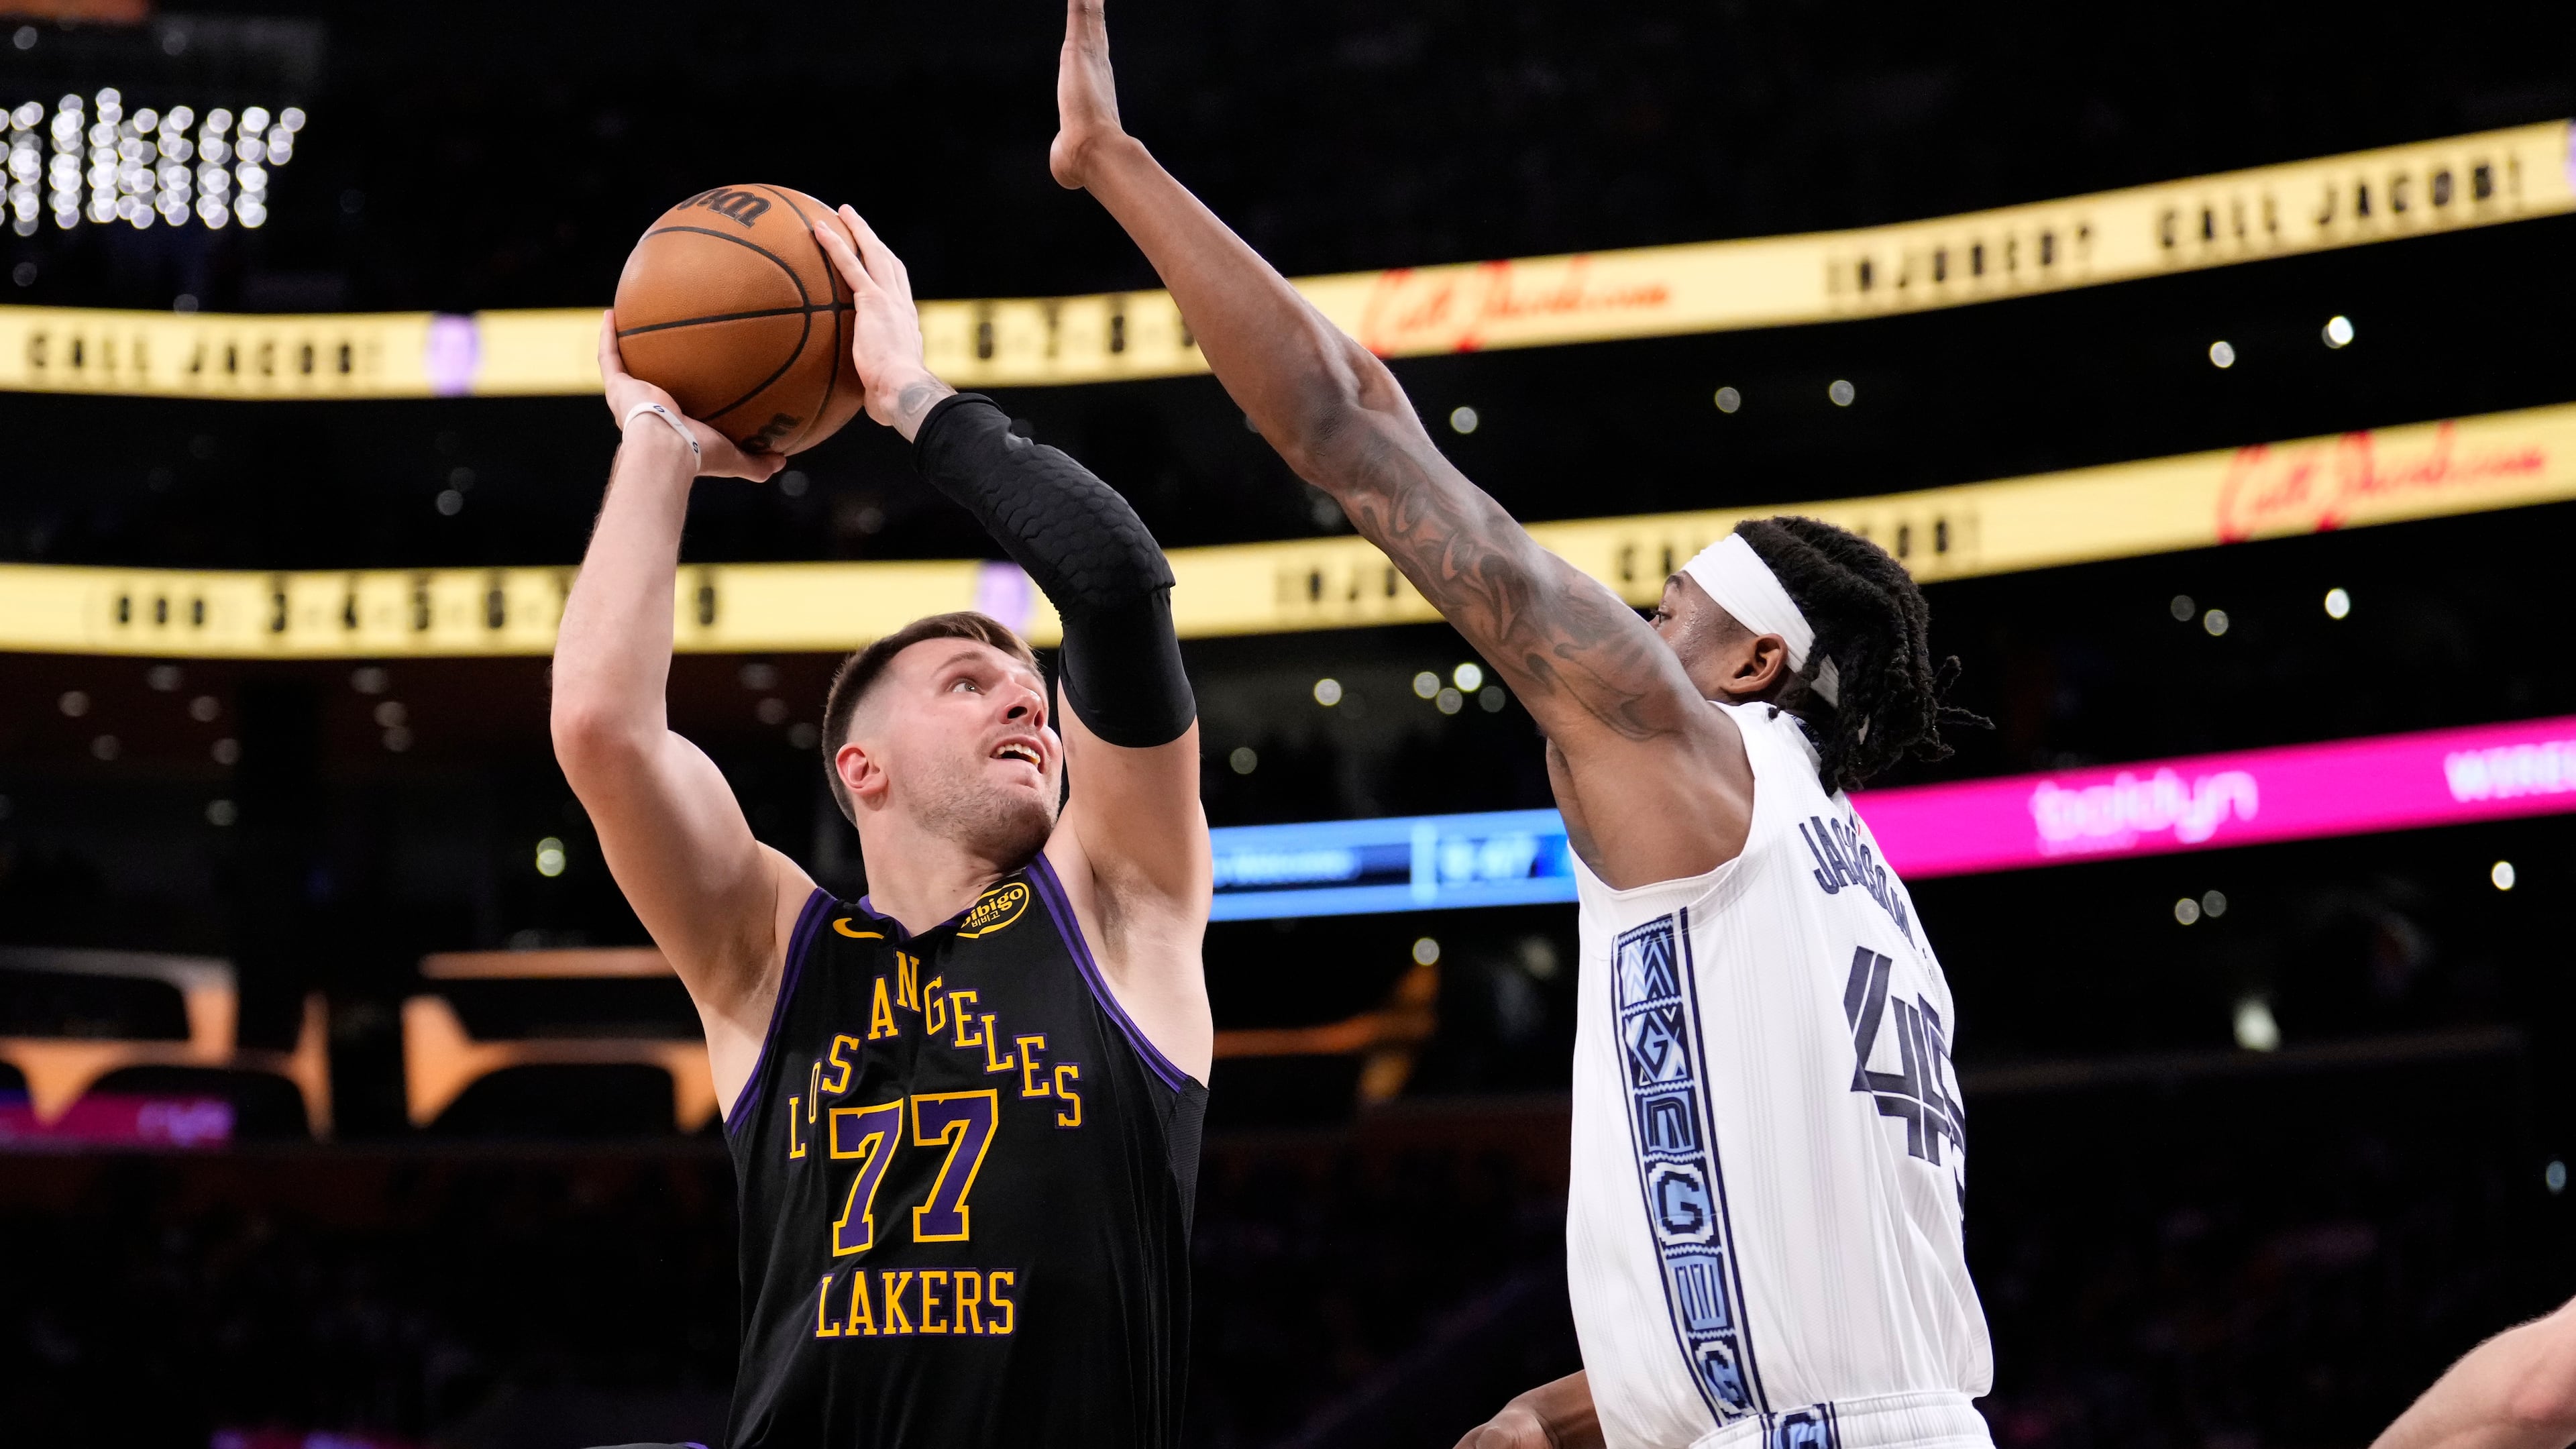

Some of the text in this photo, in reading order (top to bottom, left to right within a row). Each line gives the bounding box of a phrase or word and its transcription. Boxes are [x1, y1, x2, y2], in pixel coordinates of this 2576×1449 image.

[2156, 195, 2280, 250] CALL
[2314, 153, 2522, 227] JACOB!
[24, 329, 151, 374] CALL
[971, 909, 1002, 928] 비비고
[1799, 816, 1917, 951] JACKSON
[788, 949, 1083, 1160] LOS ANGELES
[828, 1088, 999, 1258] 77
[814, 1269, 1016, 1338] LAKERS
